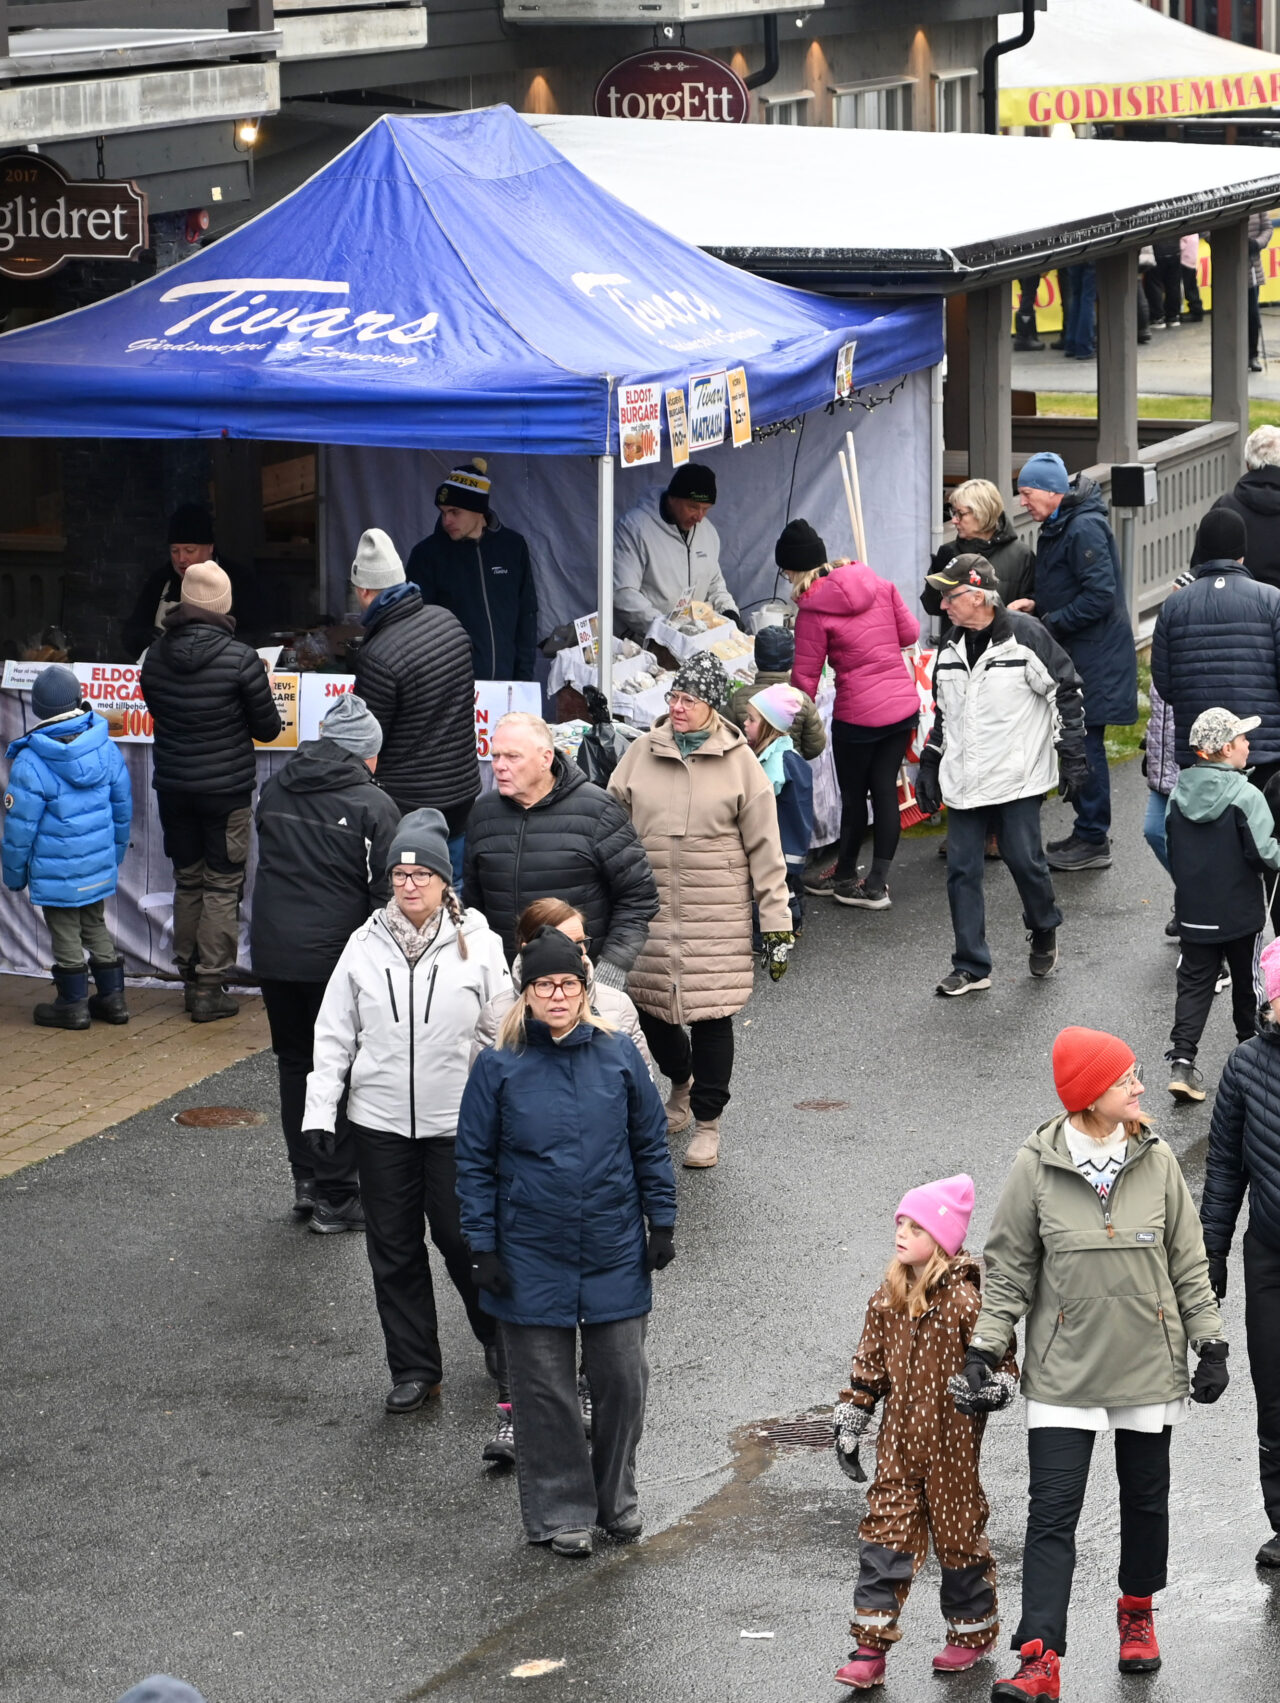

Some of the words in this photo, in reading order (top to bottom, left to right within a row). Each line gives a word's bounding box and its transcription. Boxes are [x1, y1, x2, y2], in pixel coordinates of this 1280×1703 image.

[607, 82, 734, 121] torgEtt
[5, 169, 38, 182] 2017
[159, 277, 440, 345] Tivars
[124, 337, 272, 353] Gårdsmejeri
[275, 340, 303, 351] &
[300, 345, 420, 368] Servering
[625, 387, 654, 405] ELDOST-
[620, 403, 658, 424] BURGARE
[91, 667, 142, 682] ELDOS
[80, 683, 145, 702] BURGA
[97, 701, 114, 710] med
[122, 709, 154, 737] 100
